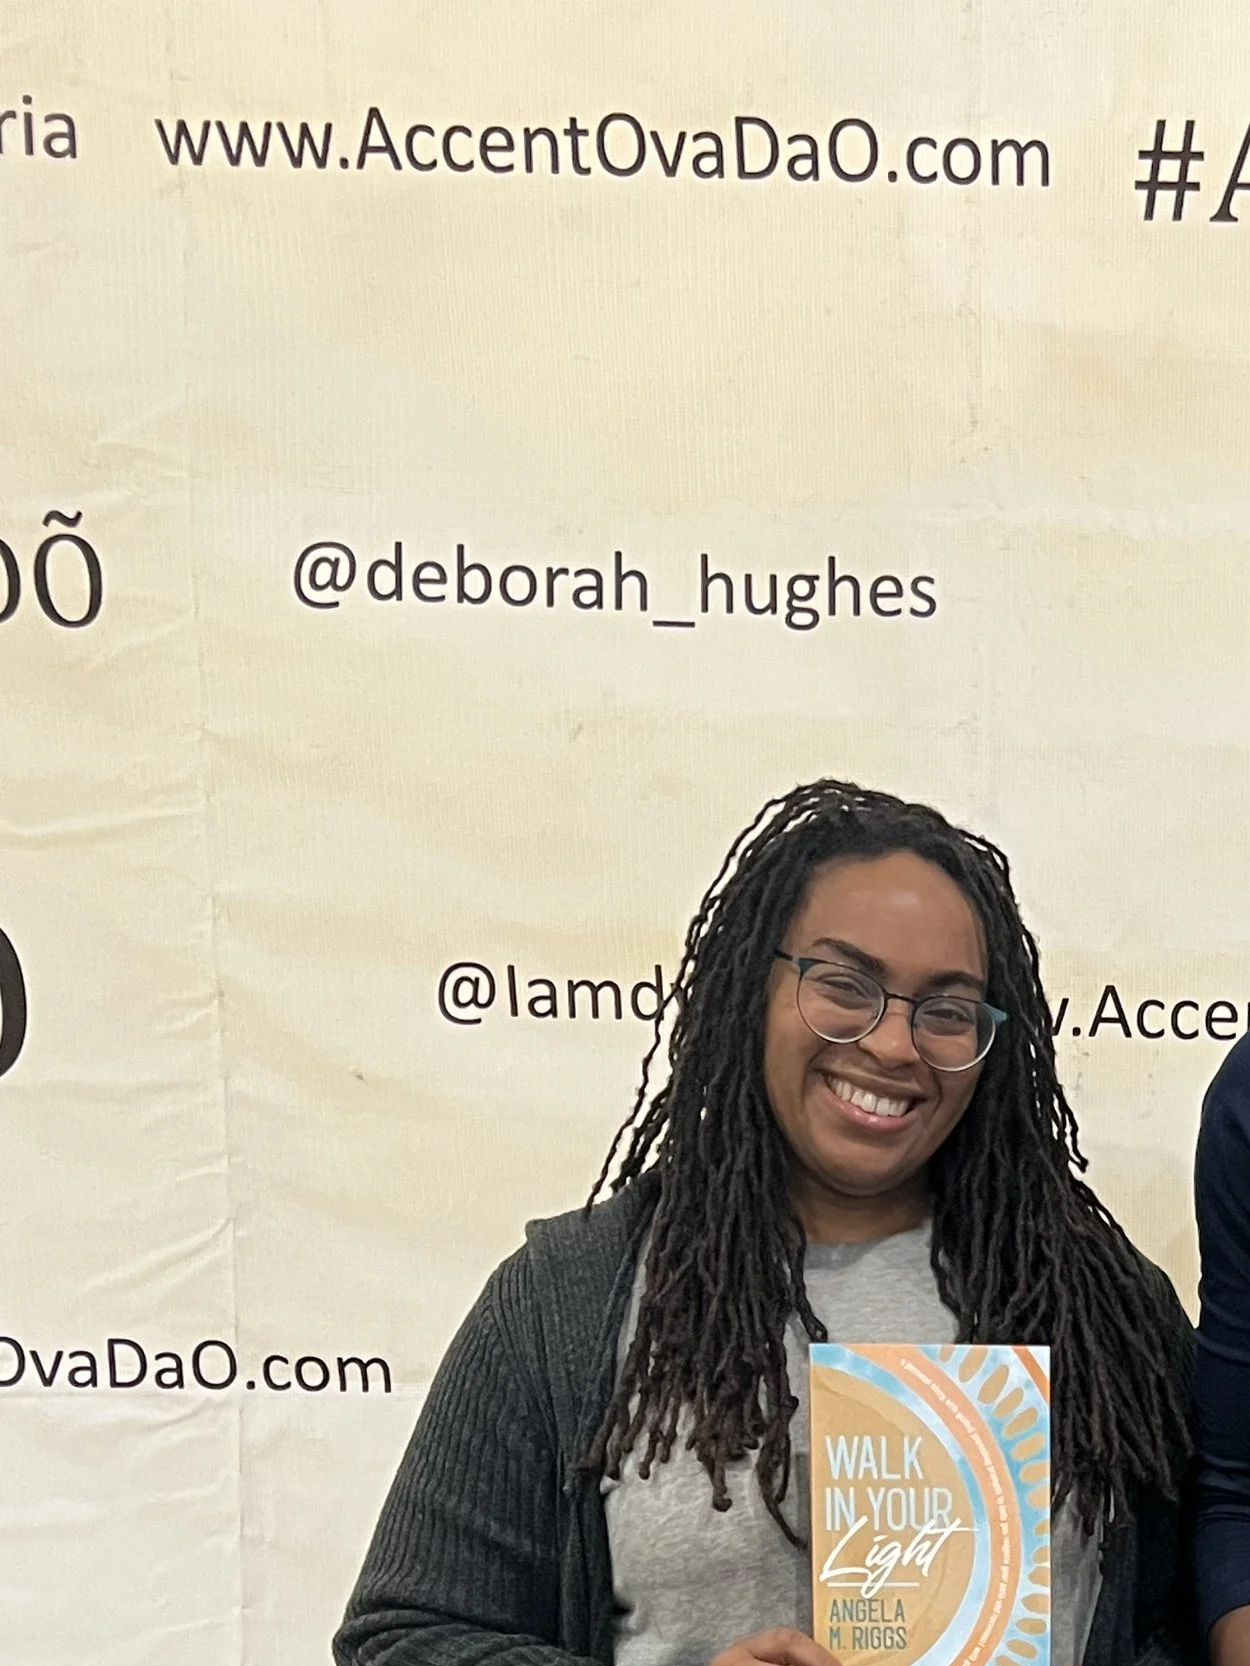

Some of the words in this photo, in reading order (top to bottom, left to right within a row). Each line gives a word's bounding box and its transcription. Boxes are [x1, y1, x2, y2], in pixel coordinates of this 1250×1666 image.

[156, 107, 1050, 188] www.AccentOvaDaO.com
[0, 509, 103, 629] Õ
[293, 540, 938, 632] @deborah_hughes
[824, 1435, 924, 1480] WALK
[824, 1486, 857, 1532] IN
[864, 1486, 953, 1532] YOUR
[819, 1514, 980, 1599] Light
[828, 1626, 847, 1651] M.
[852, 1625, 908, 1650] RIGGS
[829, 1598, 906, 1623] ANGELA
